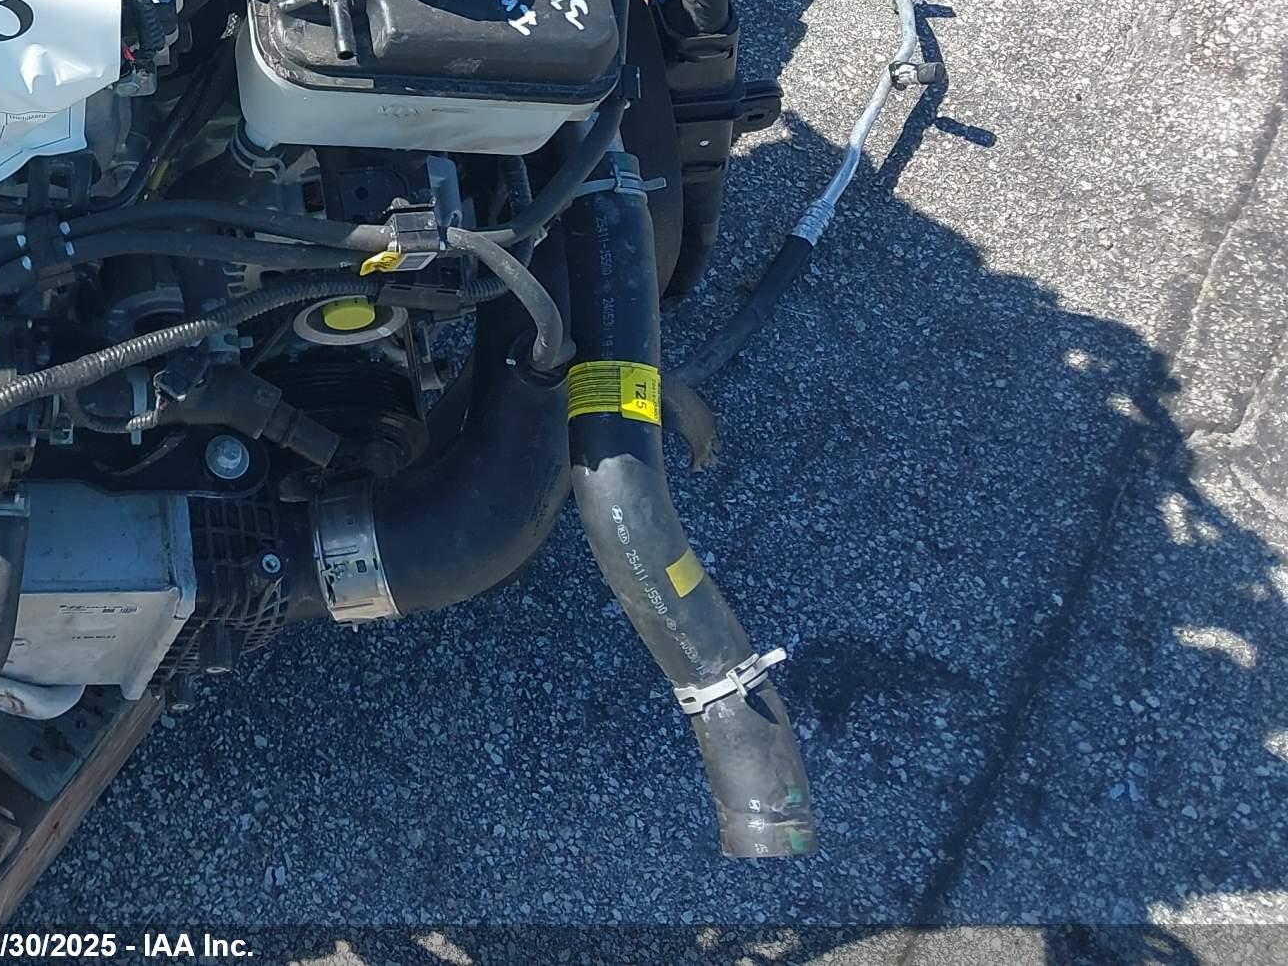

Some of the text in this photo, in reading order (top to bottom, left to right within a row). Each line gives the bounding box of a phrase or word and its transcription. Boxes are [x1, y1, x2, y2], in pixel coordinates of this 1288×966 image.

[634, 381, 648, 411] T25
[618, 525, 630, 545] KIA
[625, 549, 668, 616] 25411-J5500
